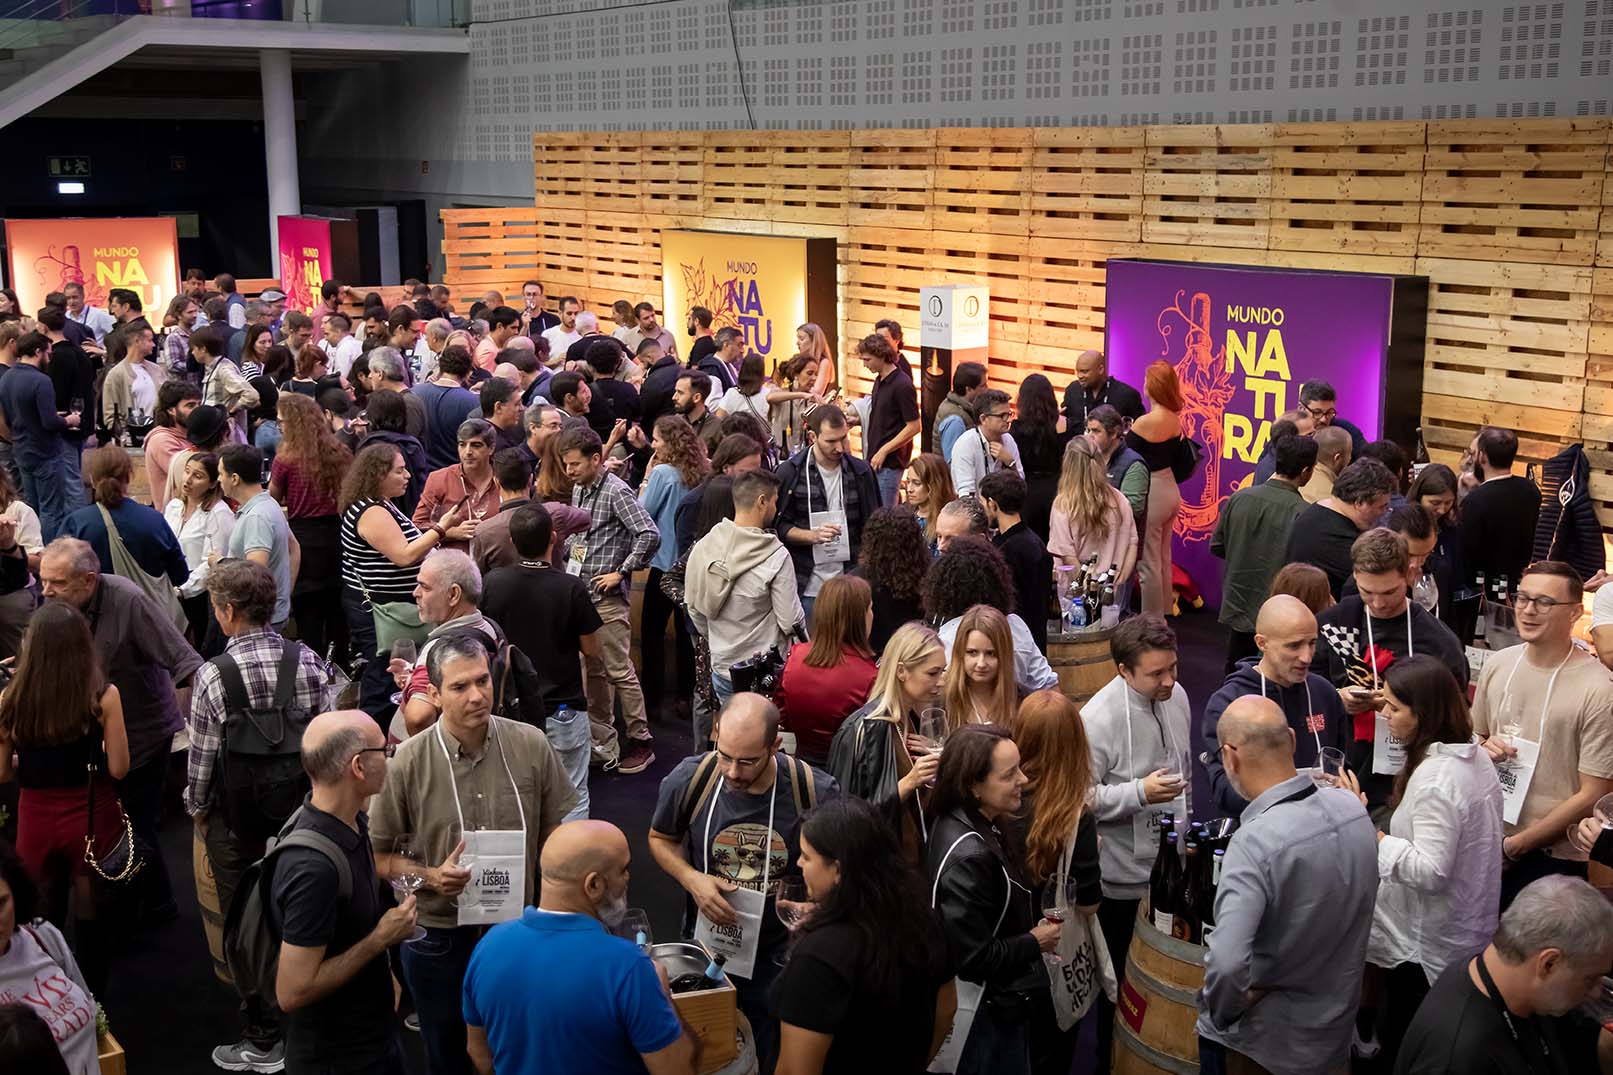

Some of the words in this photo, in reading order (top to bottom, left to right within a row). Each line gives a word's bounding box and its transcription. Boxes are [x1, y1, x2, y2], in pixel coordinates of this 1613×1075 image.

[94, 247, 139, 257] MUNDO
[96, 258, 149, 286] NA
[304, 260, 323, 288] NA
[727, 261, 757, 275] MUNDO
[728, 279, 764, 316] NA
[1227, 304, 1285, 326] MUNDO
[738, 315, 772, 355] TU
[1225, 329, 1291, 381] NA
[482, 875, 510, 886] LISBOA
[716, 924, 743, 941] LISBOA
